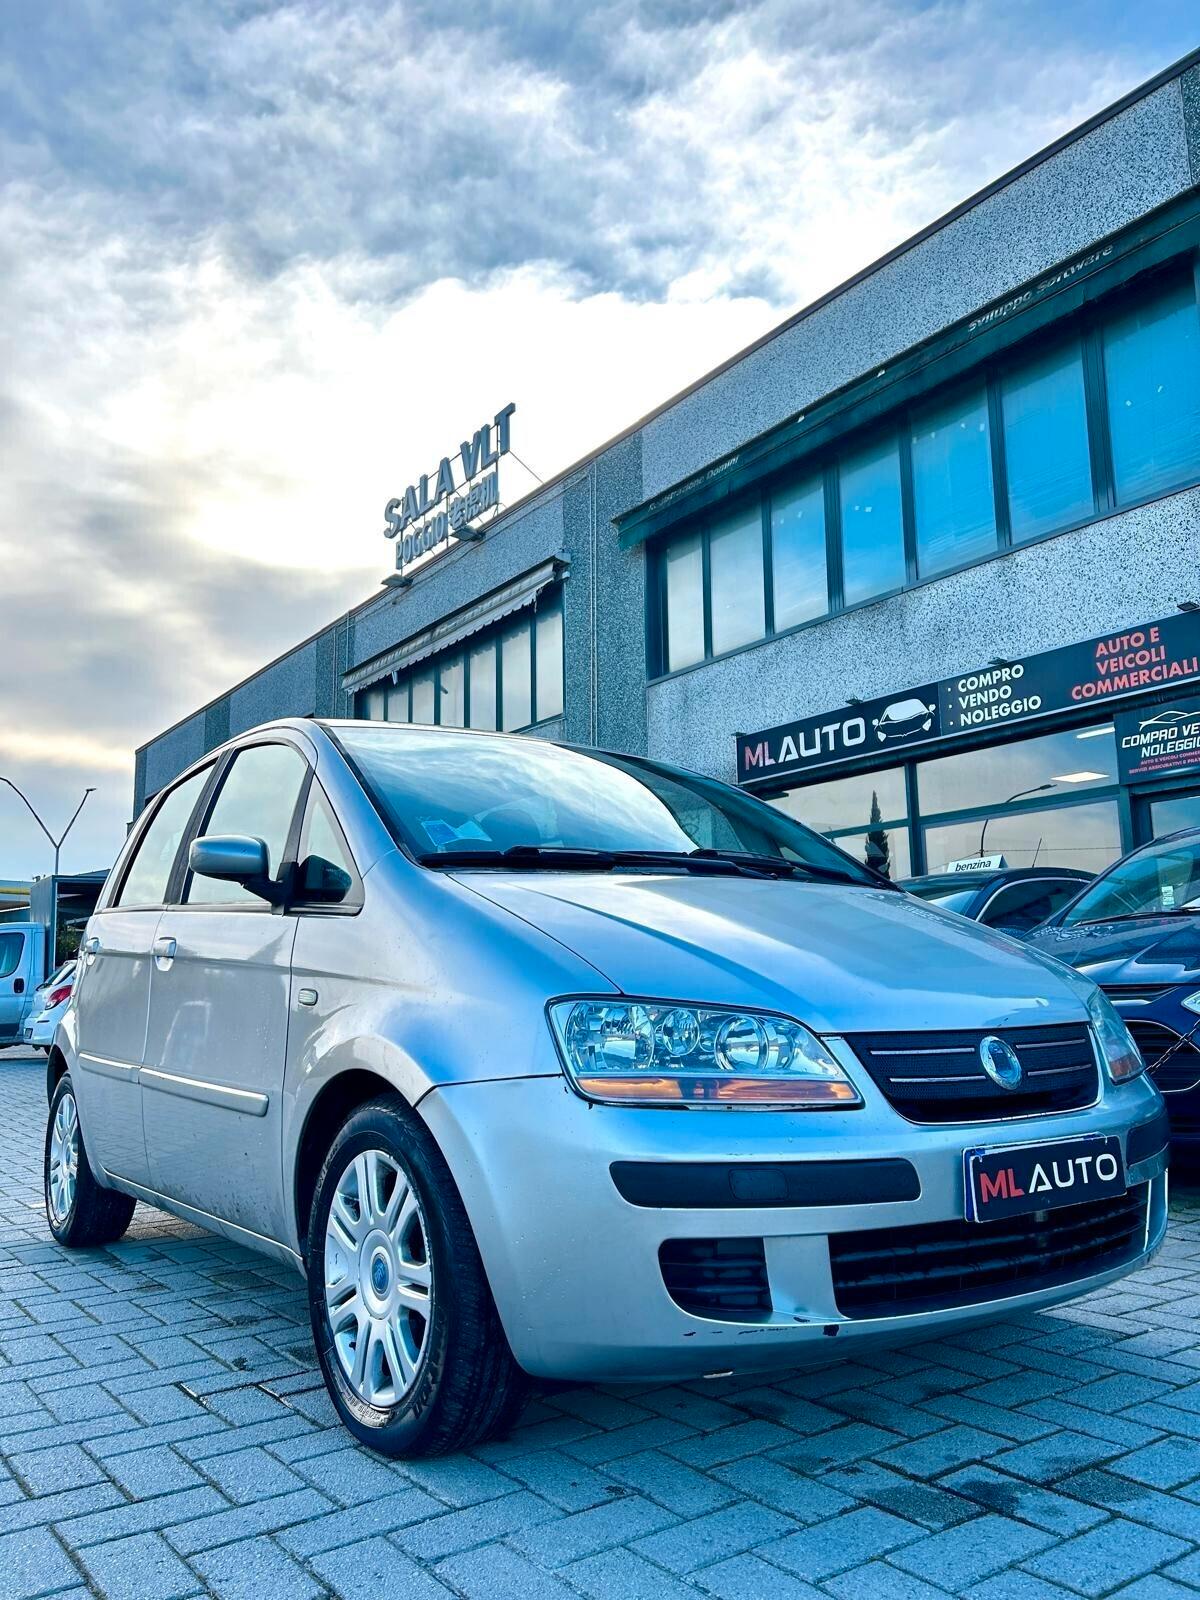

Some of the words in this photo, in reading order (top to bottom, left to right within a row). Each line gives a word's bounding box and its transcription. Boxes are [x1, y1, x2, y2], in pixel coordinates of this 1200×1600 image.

[968, 291, 1032, 333] Sviluppo
[384, 456, 456, 539] SALA
[459, 402, 516, 482] VLT
[395, 511, 449, 571] POGGIO
[1095, 631, 1146, 658] AUTO
[1149, 626, 1160, 643] E
[1095, 645, 1166, 676] VEICOLI
[957, 664, 1024, 693] COMPRO
[1071, 656, 1199, 701] COMMERCIALI
[958, 684, 1012, 710] VENDO
[960, 695, 1042, 727] NOLEGGIO
[778, 716, 866, 763] AUTO
[1121, 726, 1178, 749] COMPRO
[1140, 758, 1155, 766] AUTO
[1160, 754, 1179, 763] VEICOLI
[955, 859, 992, 872] benzina
[979, 1167, 1025, 1204] ML
[1028, 1152, 1118, 1194] AUTO
